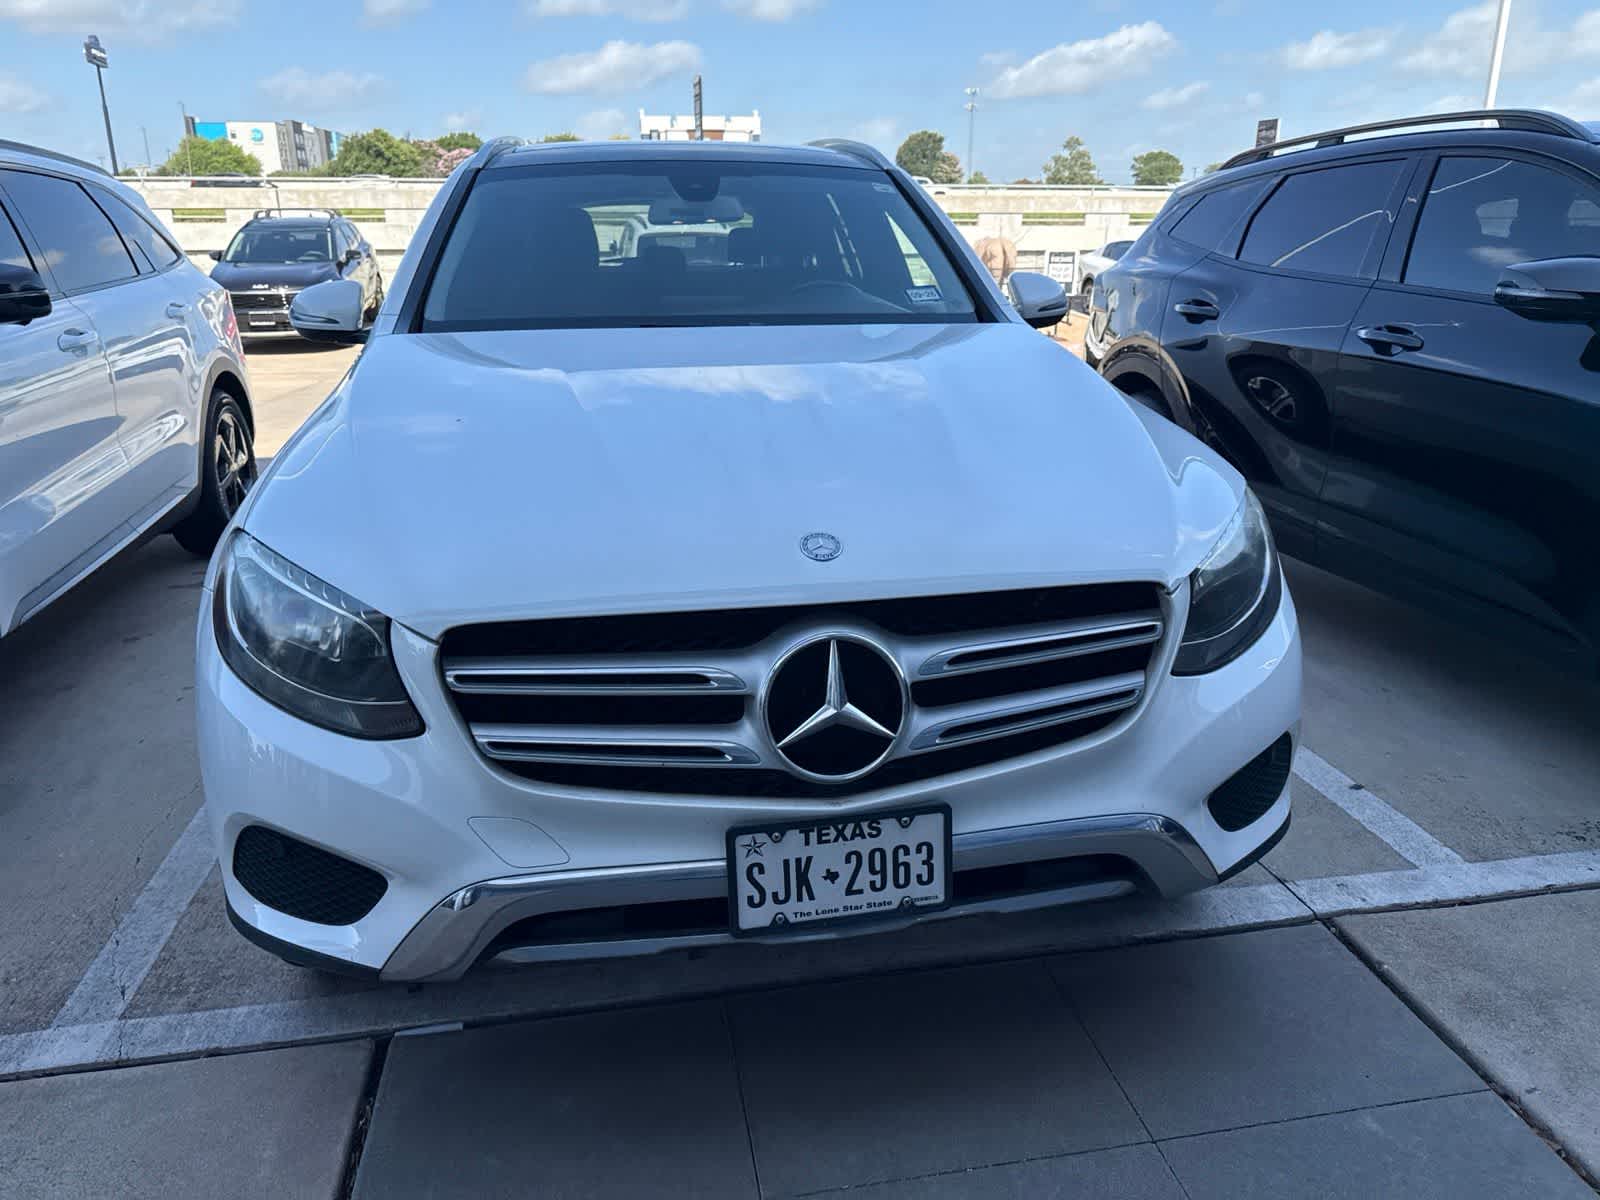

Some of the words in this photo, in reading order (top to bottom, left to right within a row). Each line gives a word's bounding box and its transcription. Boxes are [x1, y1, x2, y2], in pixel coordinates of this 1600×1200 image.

[799, 820, 882, 846] TEXAS
[746, 856, 815, 908] SJK
[845, 842, 934, 896] 2963
[793, 911, 812, 919] The
[815, 907, 839, 916] Lone
[842, 903, 864, 912] Star
[865, 899, 893, 909] State
